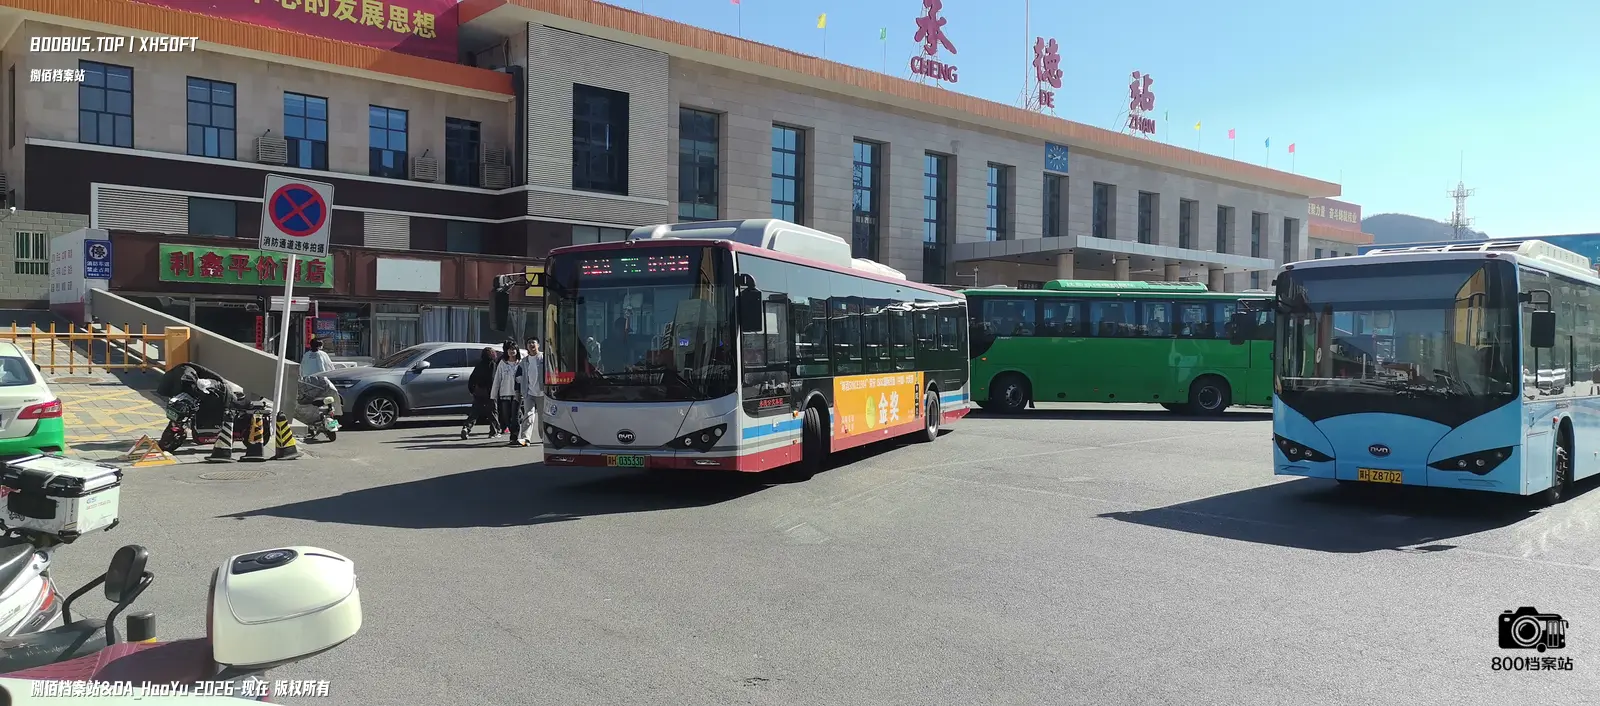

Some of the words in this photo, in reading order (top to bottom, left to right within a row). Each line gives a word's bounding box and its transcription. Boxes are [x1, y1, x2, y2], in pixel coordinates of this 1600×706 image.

[254, 0, 438, 39] 心的发展思想
[914, 0, 957, 55] 承
[1033, 36, 1063, 88] 德
[1129, 71, 1155, 111] 站
[910, 56, 958, 83] CHENG
[1039, 89, 1055, 108] DE
[1128, 113, 1156, 134] ZHAN
[263, 236, 325, 254] 消防通道违停拍摄
[169, 250, 327, 284] 利鑫平价商店
